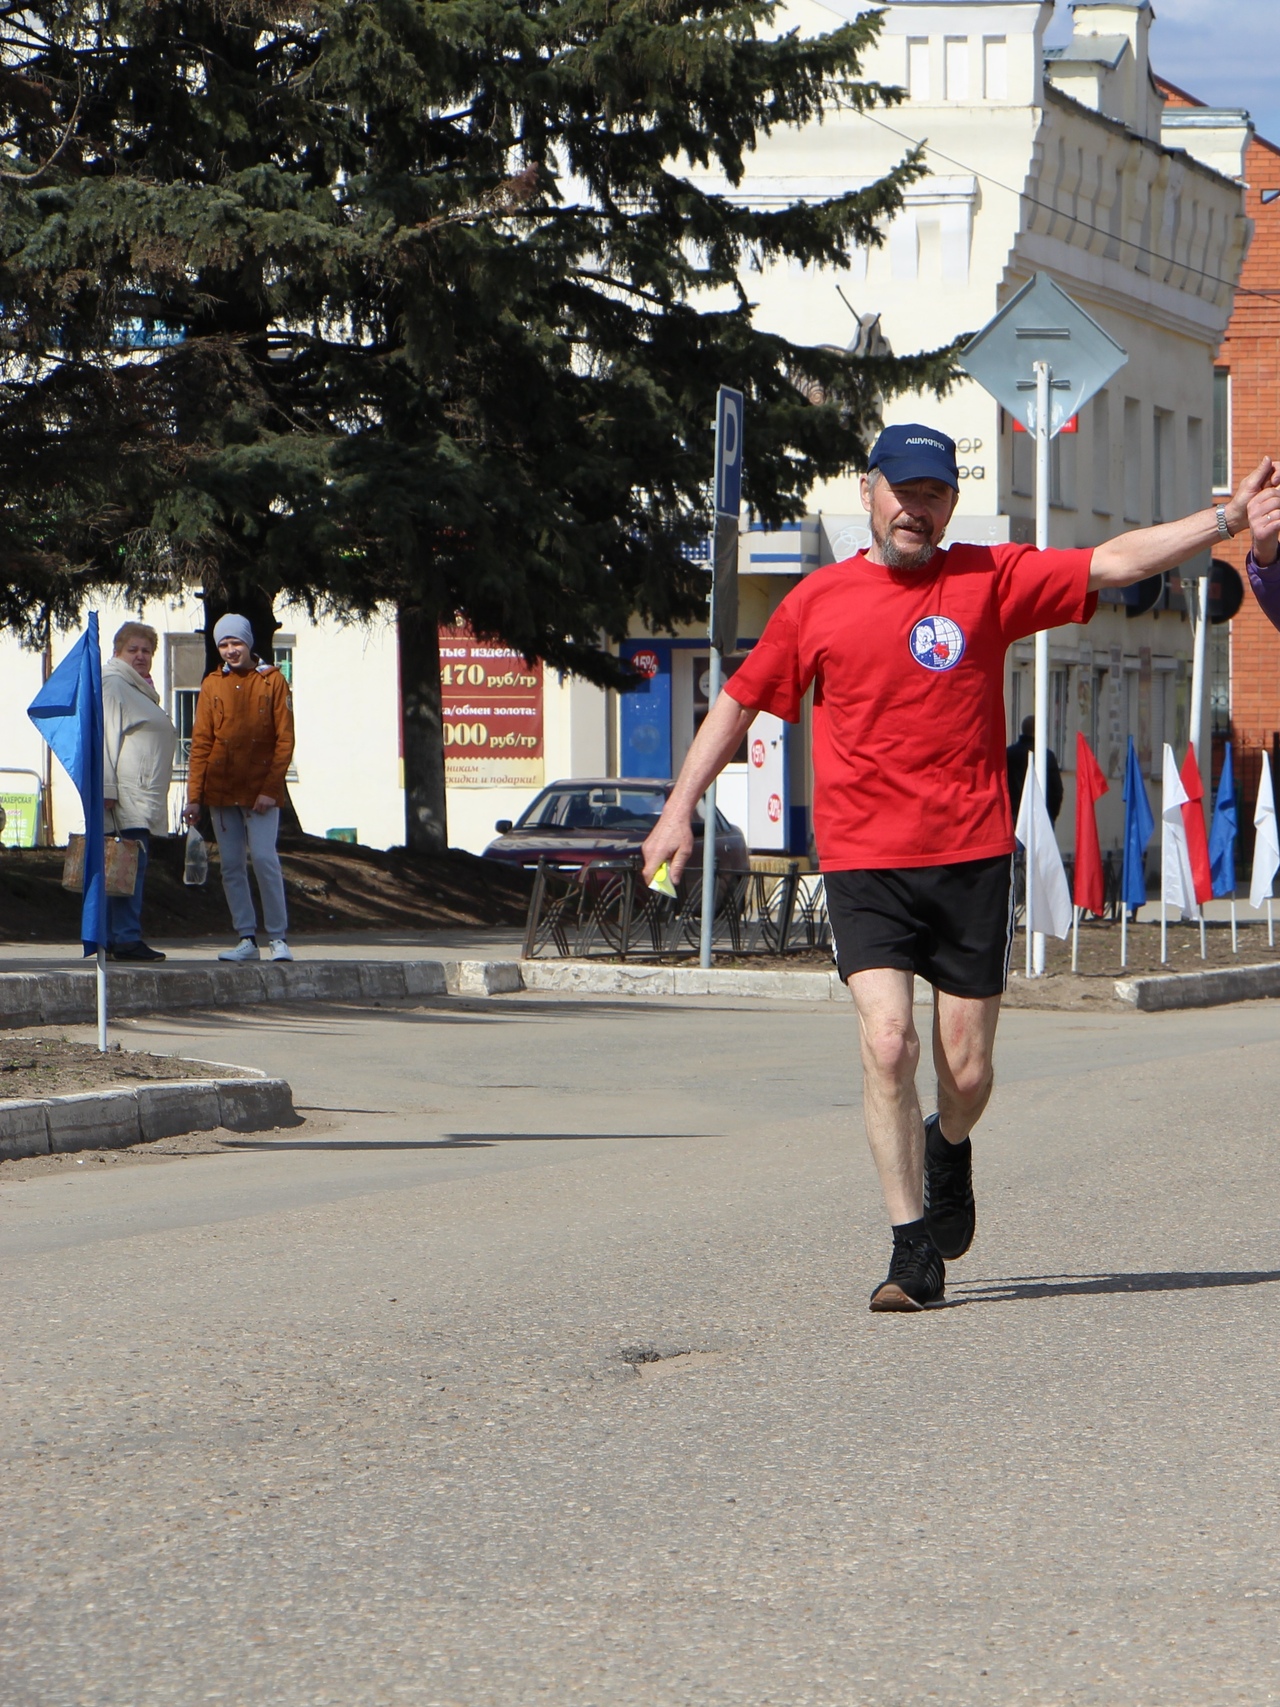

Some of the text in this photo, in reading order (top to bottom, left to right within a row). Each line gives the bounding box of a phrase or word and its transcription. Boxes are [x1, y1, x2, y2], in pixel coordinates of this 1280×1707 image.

[905, 436, 946, 452] АШУКИНО
[721, 396, 739, 509] P
[439, 648, 466, 658] тые
[633, 655, 658, 674] 15%
[440, 664, 536, 688] 470 руб/гр
[443, 704, 537, 717] а/обмен золота:
[443, 722, 536, 748] 000 руб/гр
[445, 765, 480, 773] никам
[489, 775, 537, 786] подарки!
[0, 796, 32, 804] МАХЕРСКАЯ
